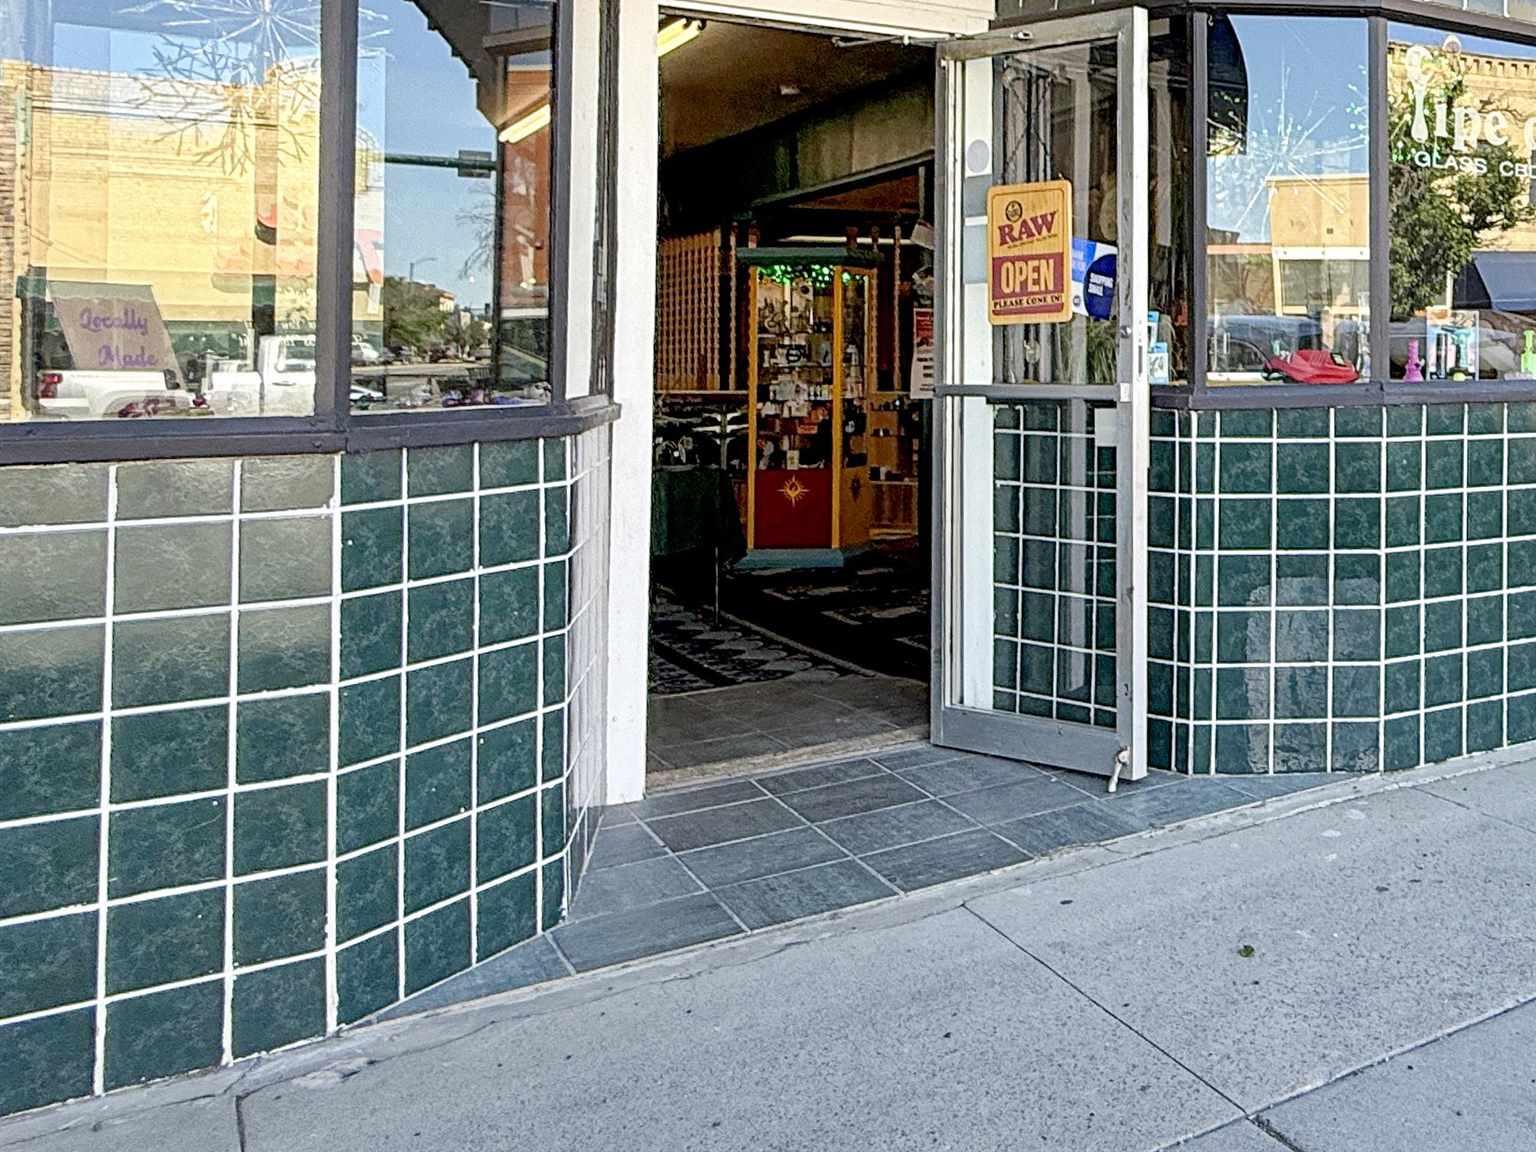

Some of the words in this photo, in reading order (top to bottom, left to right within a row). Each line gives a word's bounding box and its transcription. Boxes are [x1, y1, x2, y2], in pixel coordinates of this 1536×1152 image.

[998, 211, 1057, 246] RAW
[1001, 259, 1055, 294] OPEN
[993, 298, 1025, 309] PLEASE
[79, 306, 149, 336] Locally
[98, 344, 159, 367] Made
